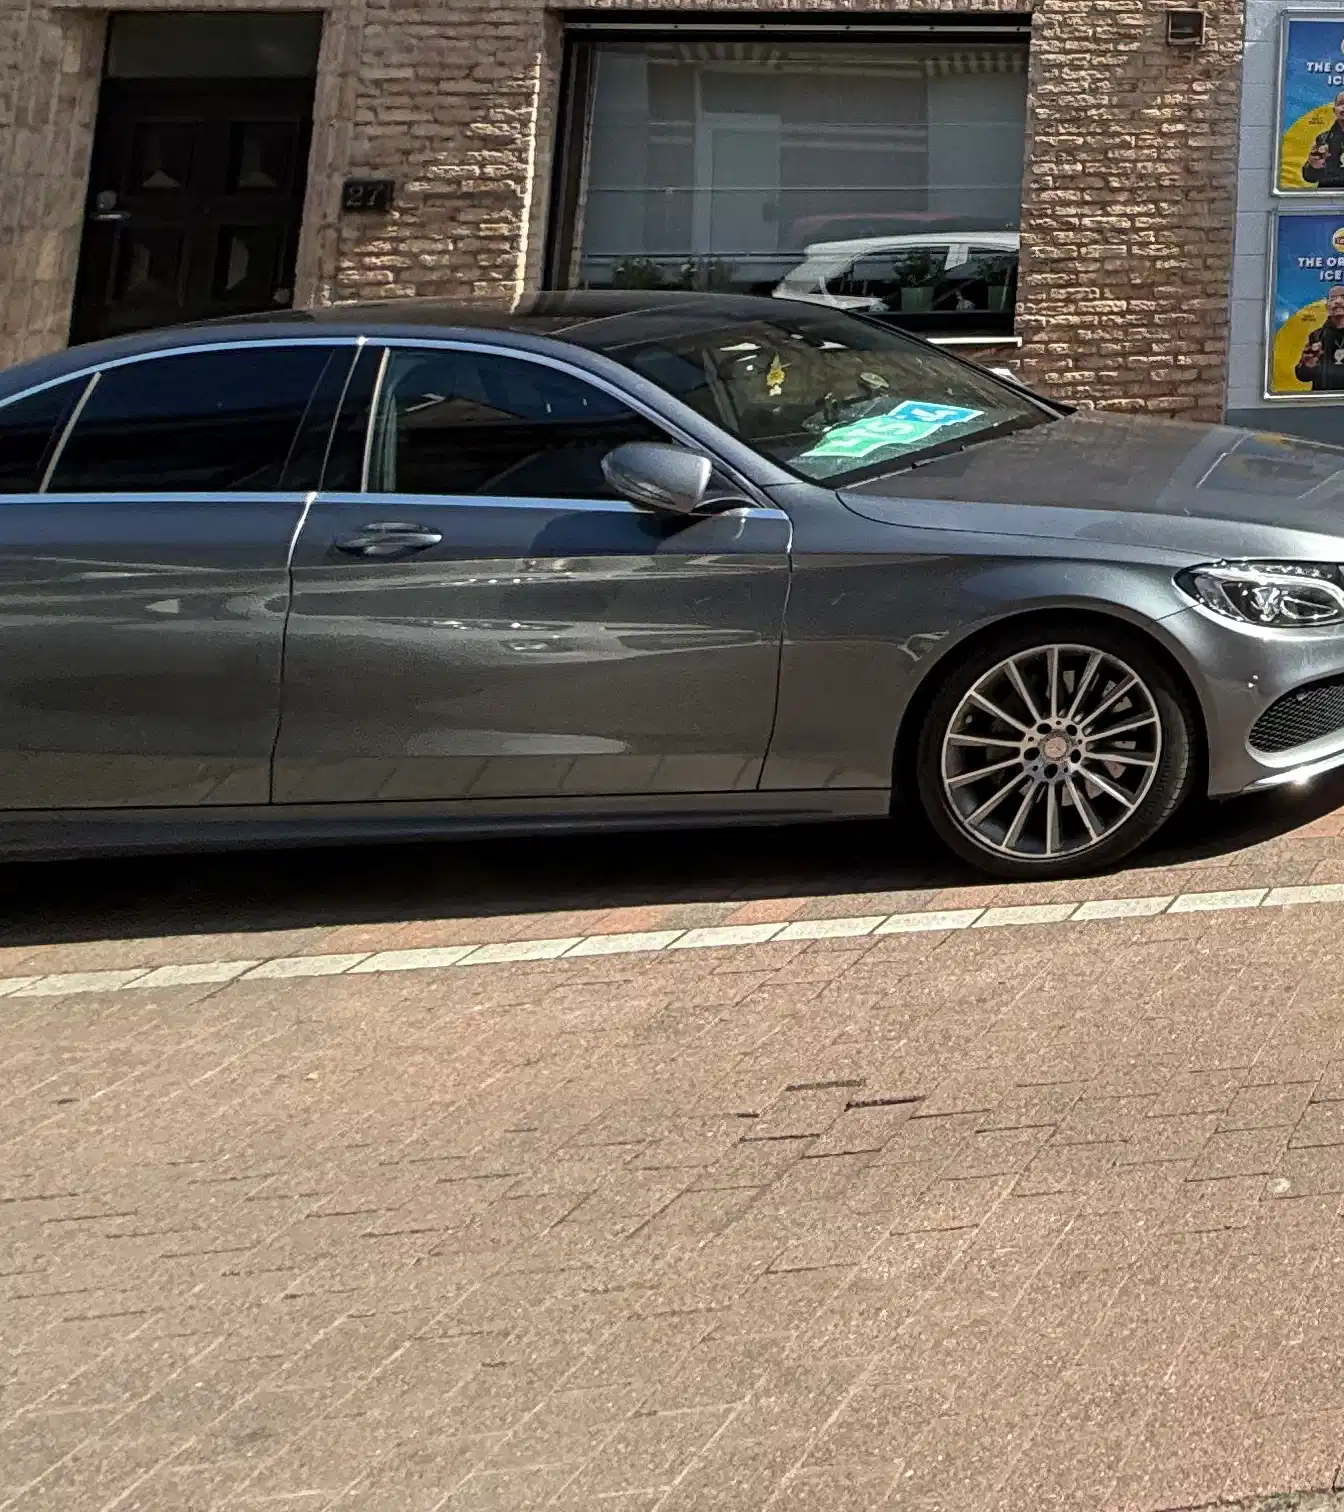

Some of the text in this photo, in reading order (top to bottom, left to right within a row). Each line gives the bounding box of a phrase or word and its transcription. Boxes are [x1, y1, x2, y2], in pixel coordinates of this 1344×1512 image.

[1306, 61, 1332, 74] THE
[1297, 257, 1323, 268] THE
[1320, 270, 1343, 281] ICE
